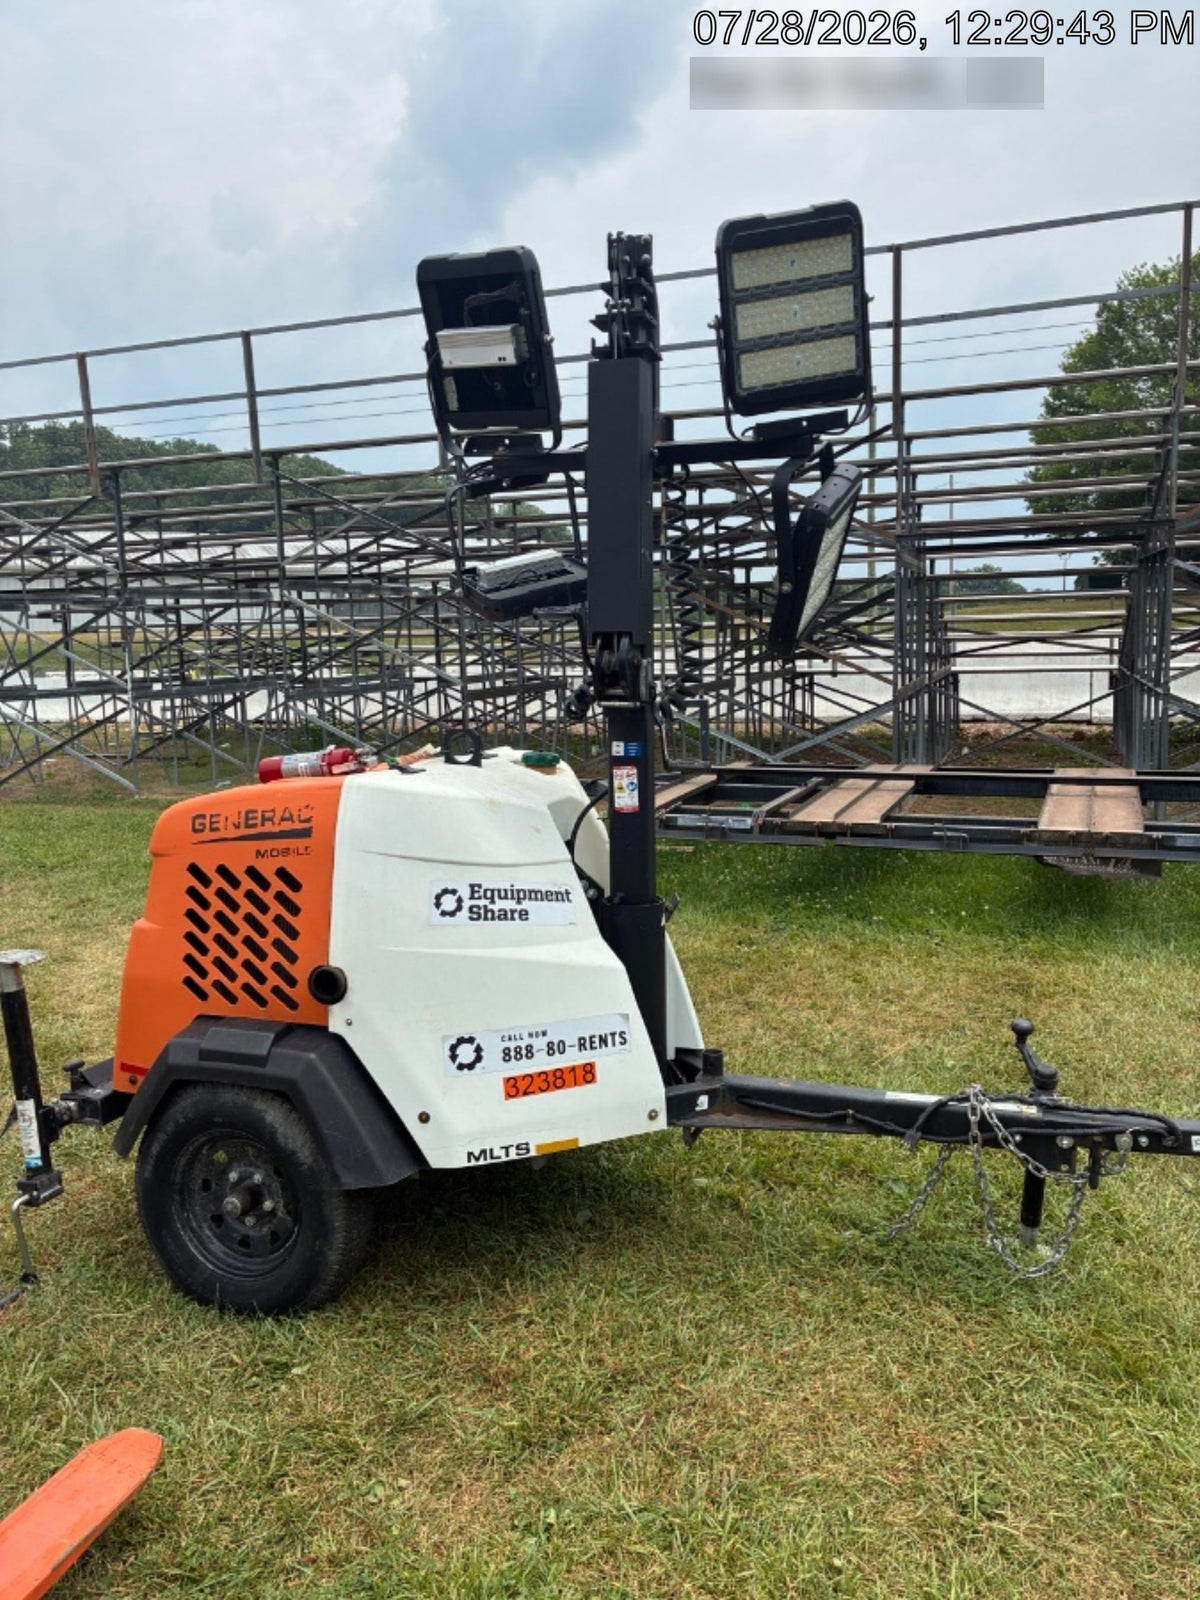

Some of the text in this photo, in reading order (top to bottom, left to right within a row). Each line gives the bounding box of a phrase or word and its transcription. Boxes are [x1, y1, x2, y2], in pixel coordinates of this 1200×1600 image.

[468, 883, 573, 905] Equipment
[468, 905, 530, 921] Share
[500, 1029, 548, 1042] CALL NOW
[502, 1031, 627, 1063] 888-80-RENTS
[505, 1063, 596, 1099] 323818
